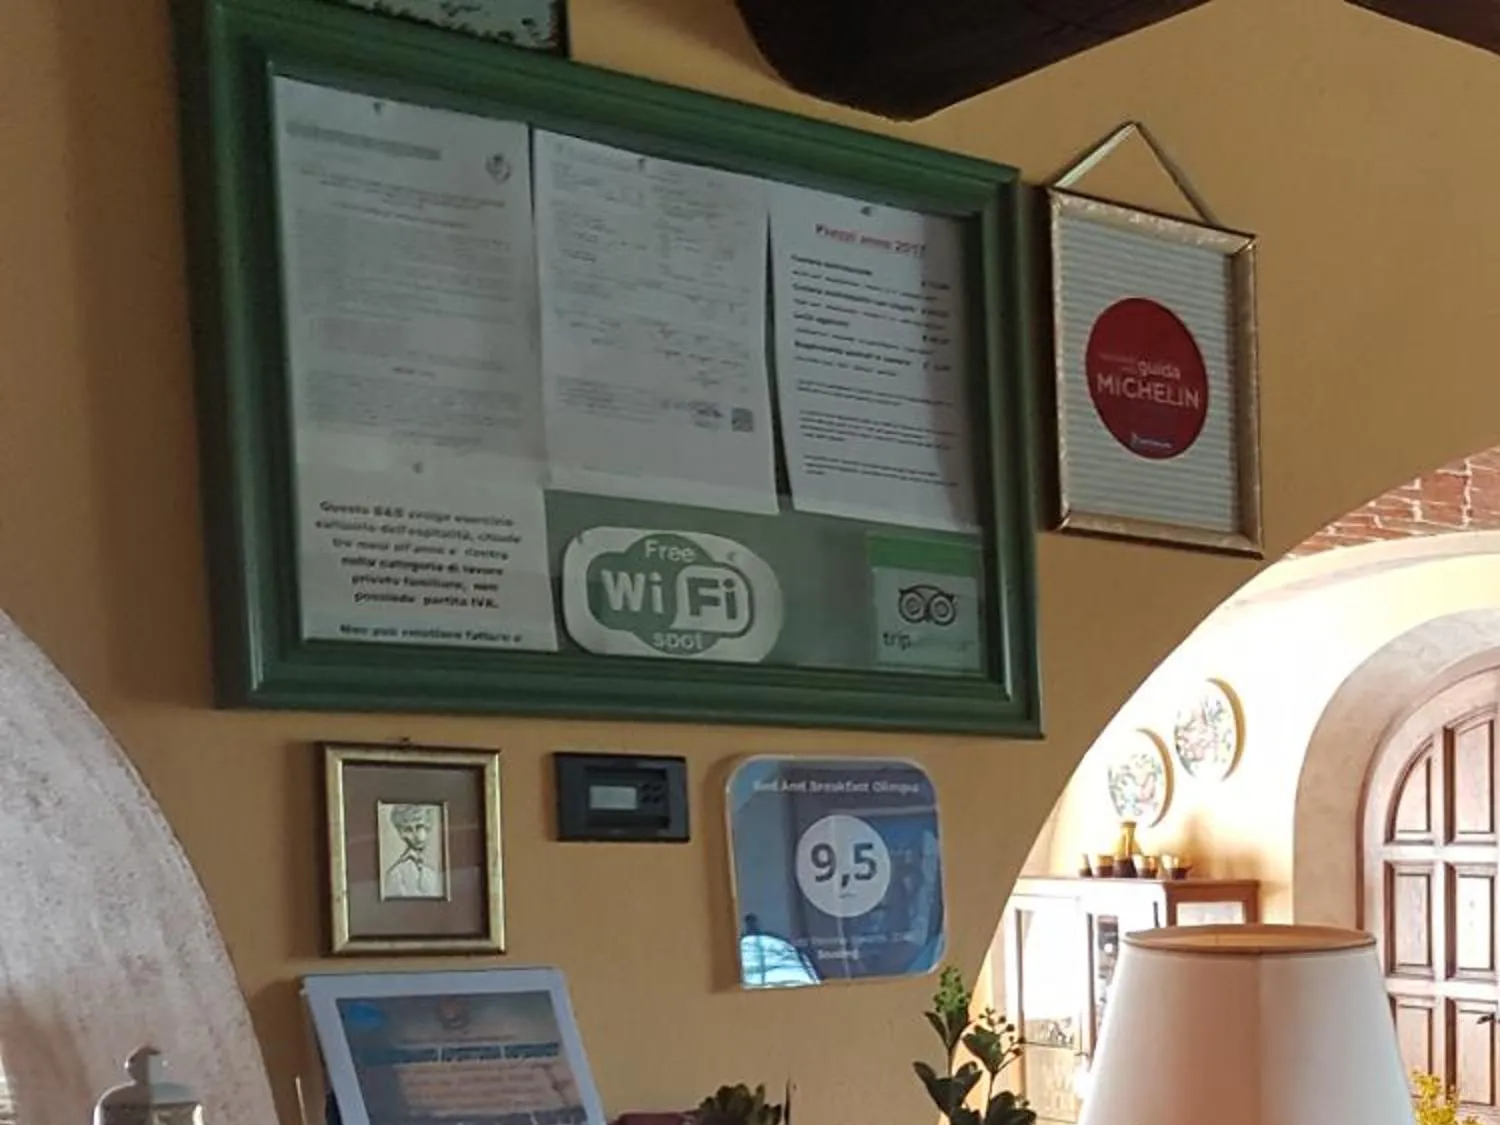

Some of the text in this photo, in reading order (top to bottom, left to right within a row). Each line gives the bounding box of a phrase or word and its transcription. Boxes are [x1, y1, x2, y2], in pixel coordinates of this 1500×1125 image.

[1096, 373, 1200, 410] MICHELIN
[319, 500, 370, 515] Questo
[644, 539, 697, 563] Free
[810, 779, 869, 793] Breakfast
[809, 842, 879, 888] 9,5
